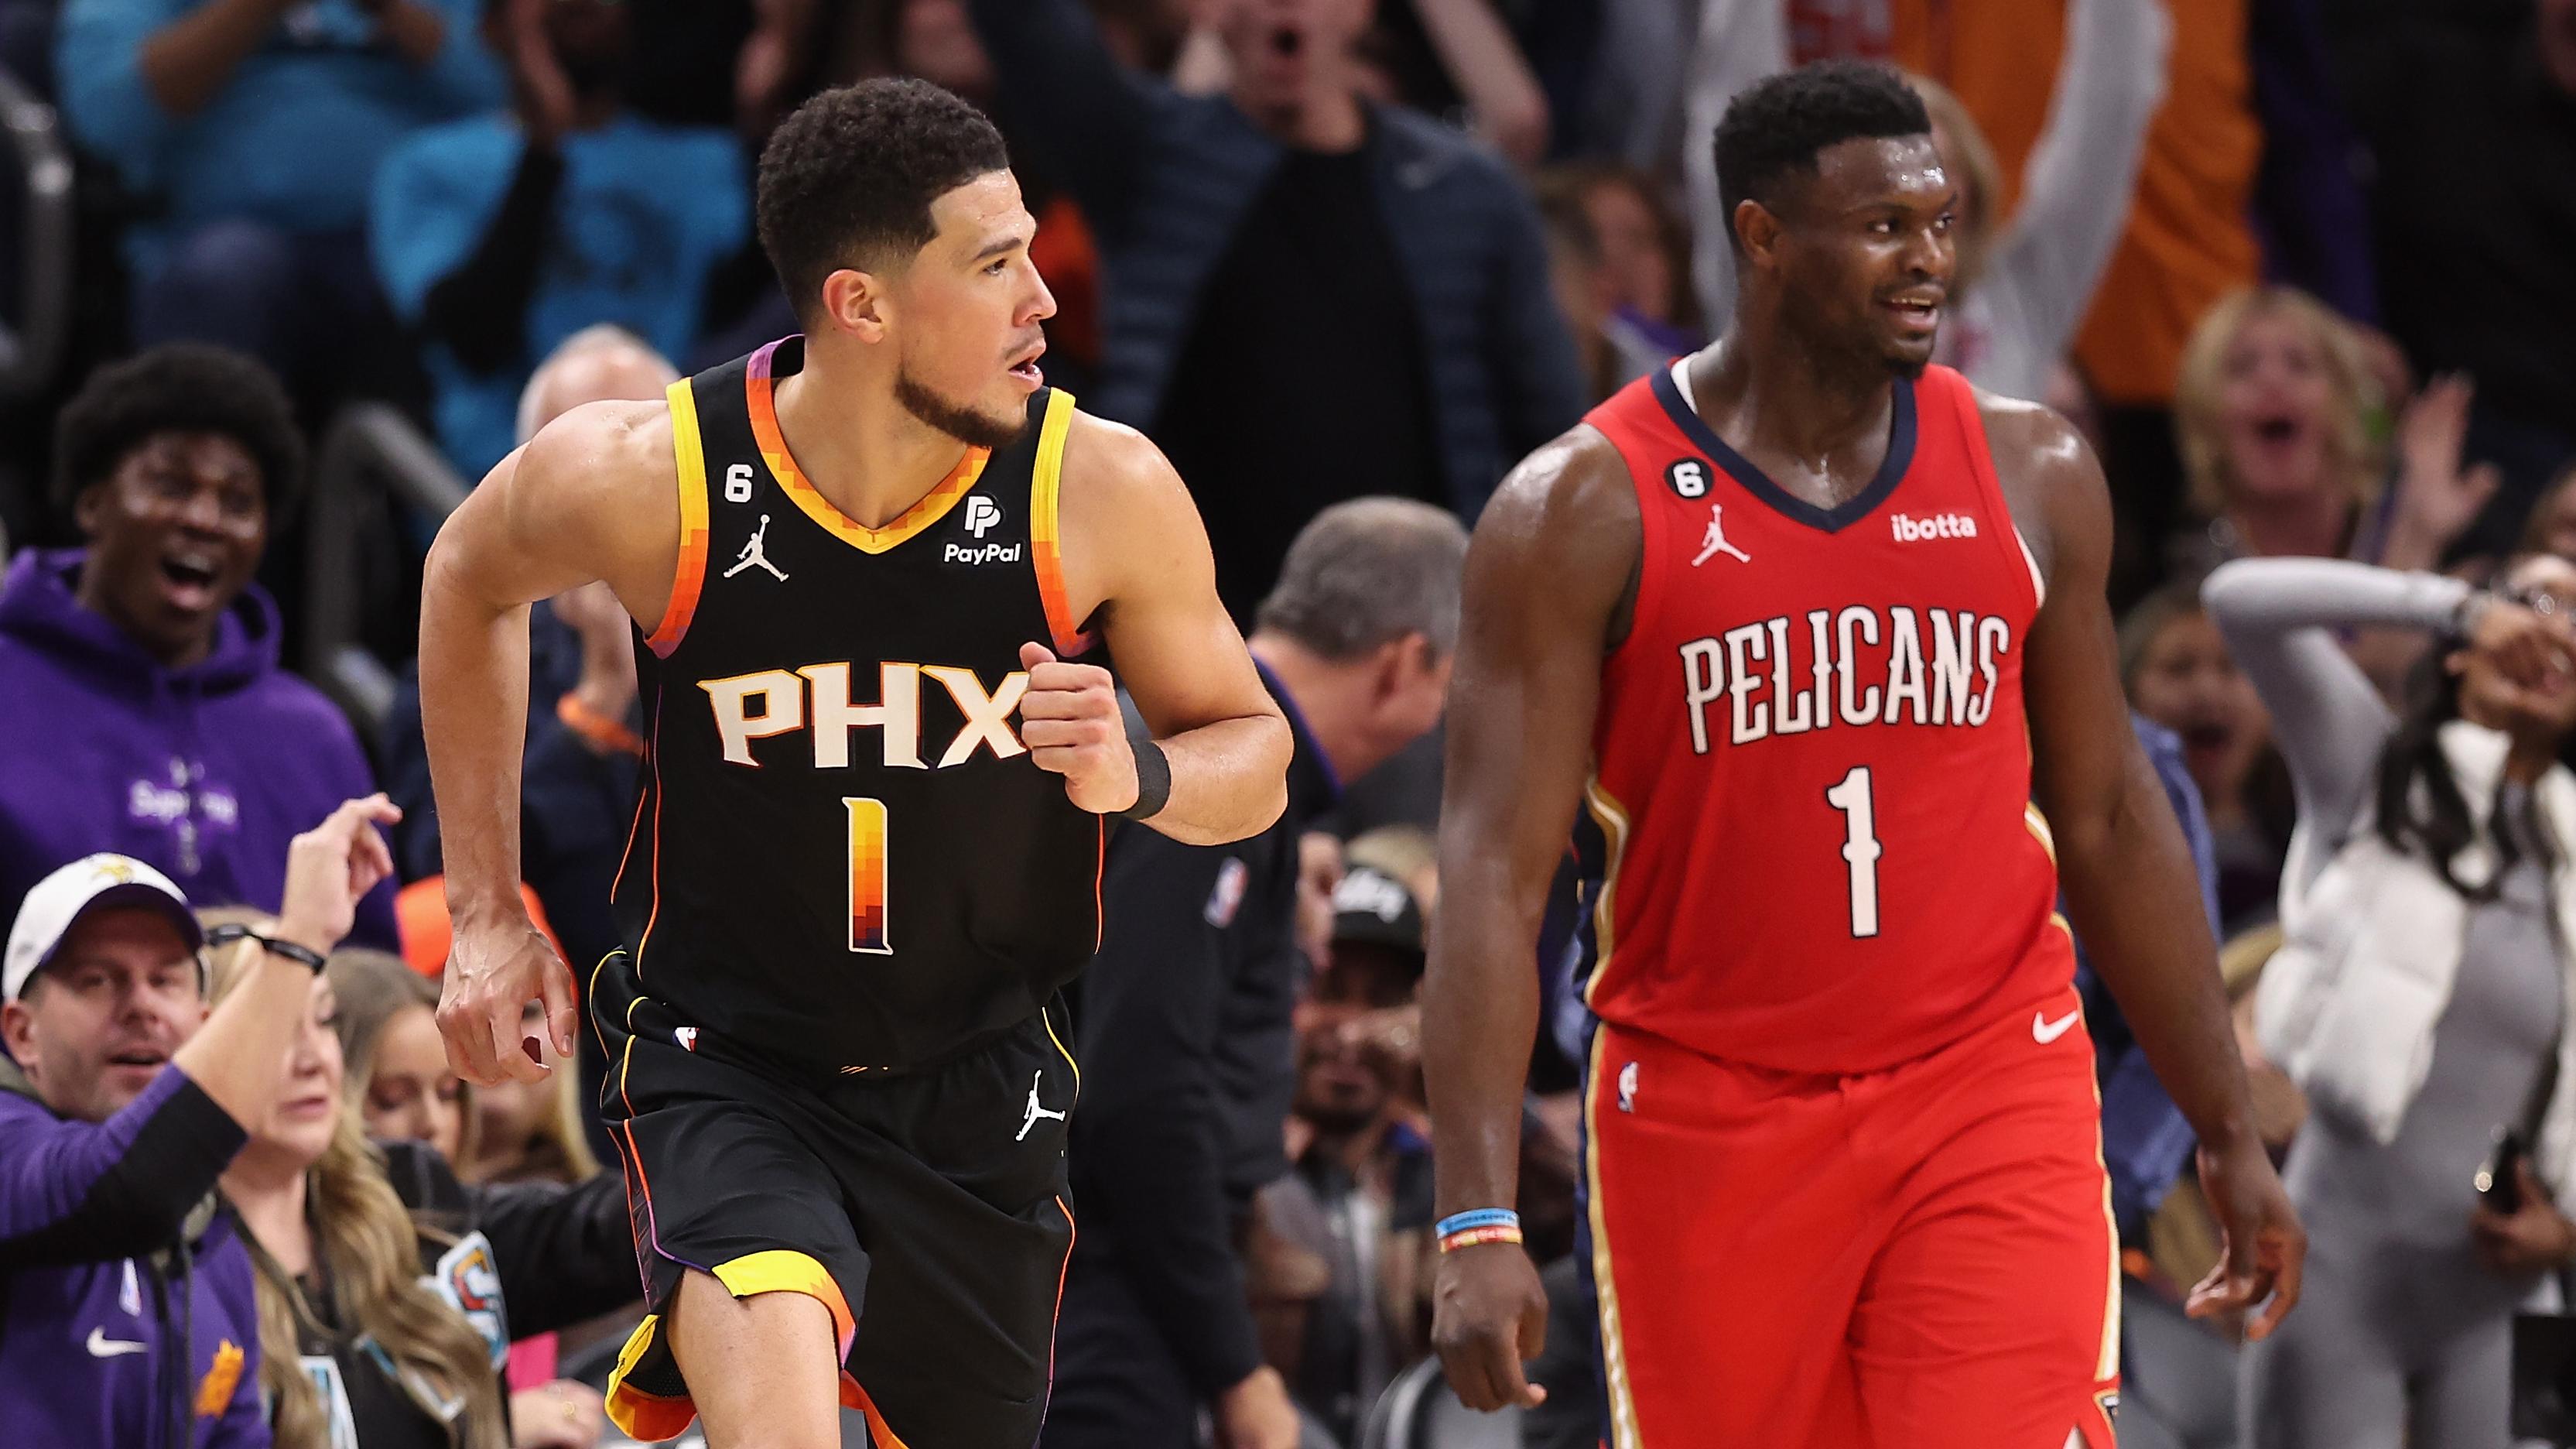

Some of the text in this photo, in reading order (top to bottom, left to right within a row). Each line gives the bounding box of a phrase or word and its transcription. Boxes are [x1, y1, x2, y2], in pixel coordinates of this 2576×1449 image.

[724, 464, 753, 502] 6
[1674, 462, 1705, 497] 6
[944, 543, 1021, 565] PayPal
[1890, 512, 1977, 542] ibotta
[696, 662, 1031, 769] PHX
[1680, 605, 2010, 754] PELICANS
[842, 796, 893, 955] 1
[1825, 766, 1882, 937] 1
